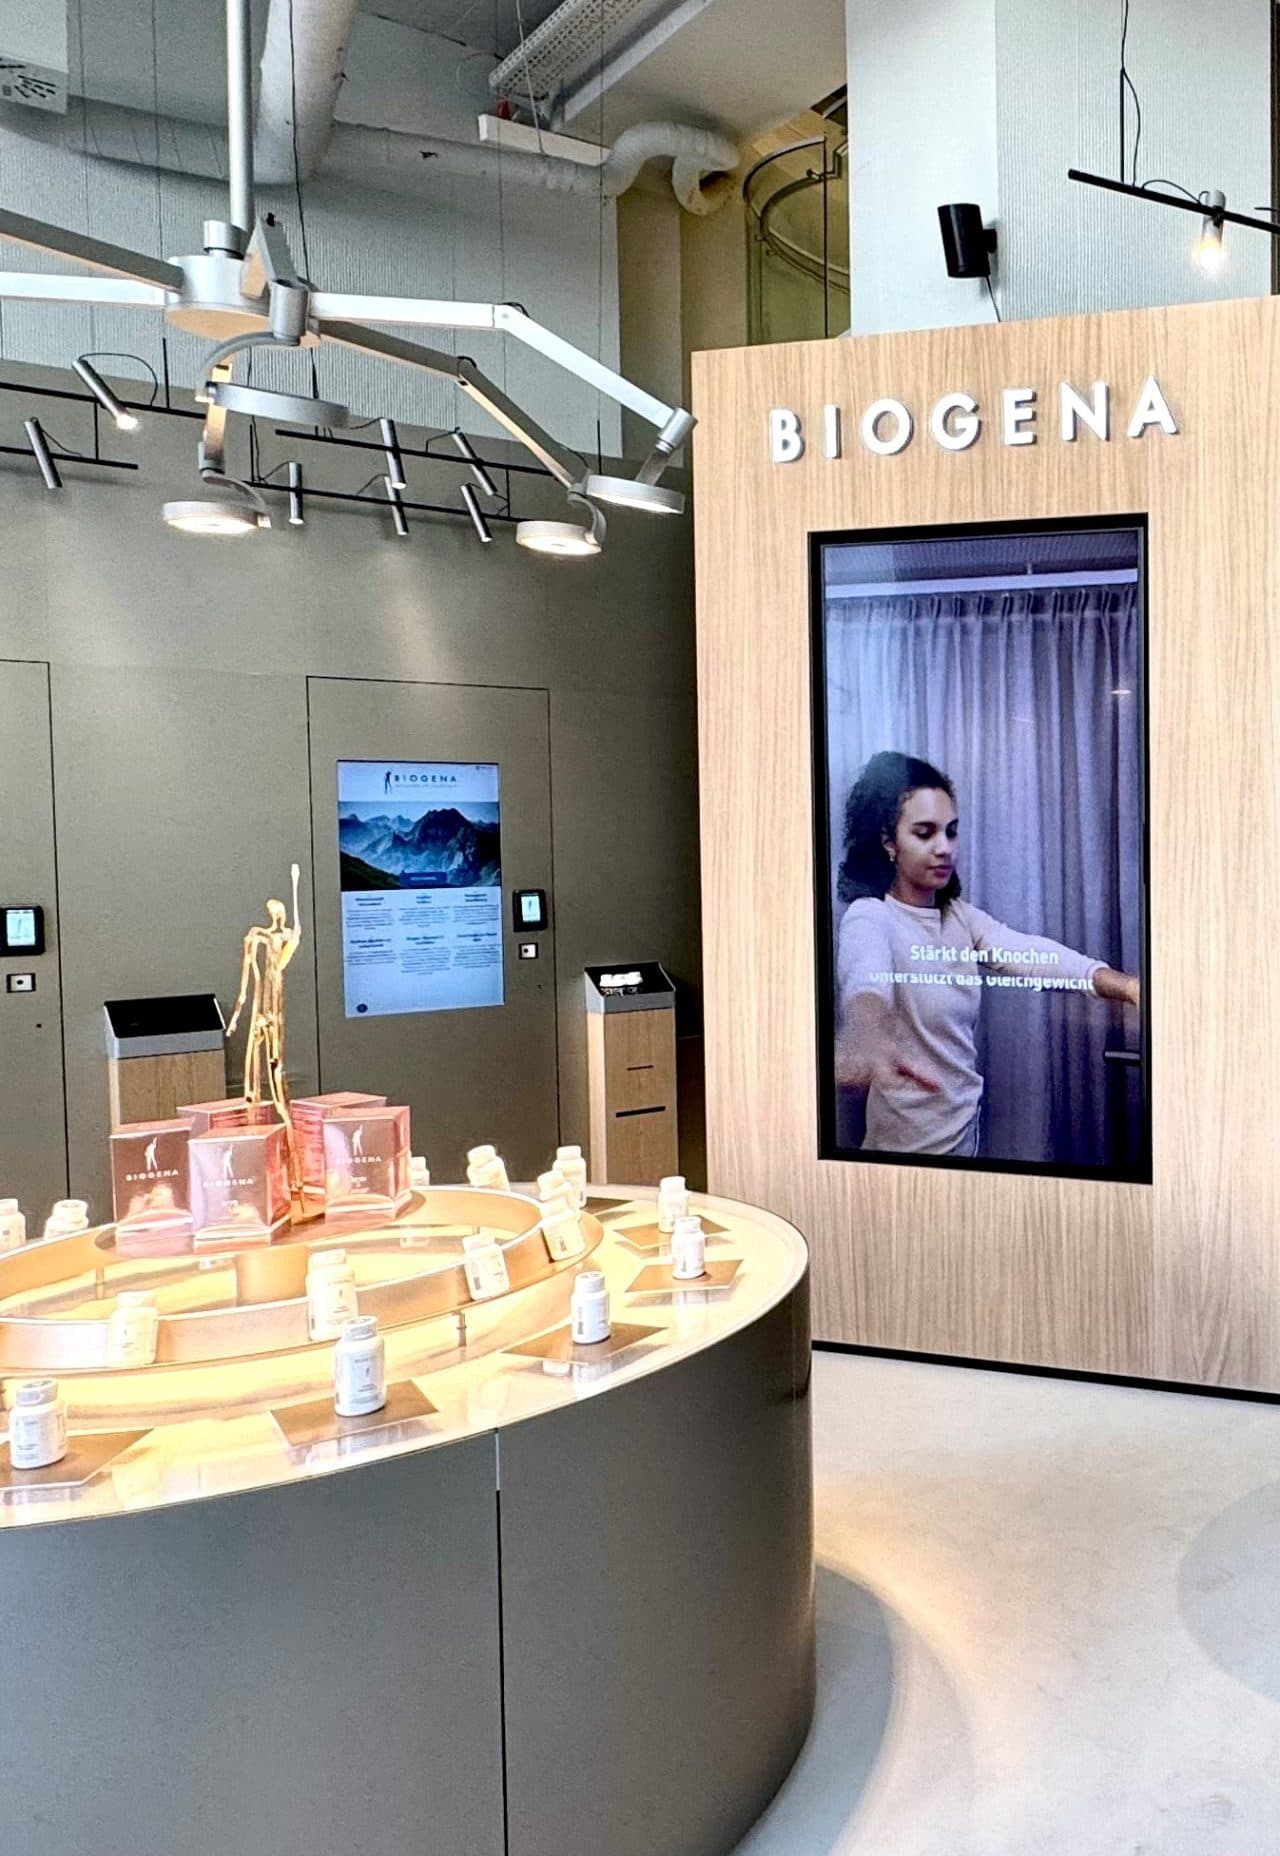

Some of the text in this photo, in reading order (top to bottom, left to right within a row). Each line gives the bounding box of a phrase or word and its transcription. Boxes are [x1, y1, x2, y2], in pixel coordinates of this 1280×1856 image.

[770, 374, 1179, 463] BIOGENA
[394, 774, 457, 783] BIOGENA
[910, 944, 1059, 965] Stärkt den Knochen
